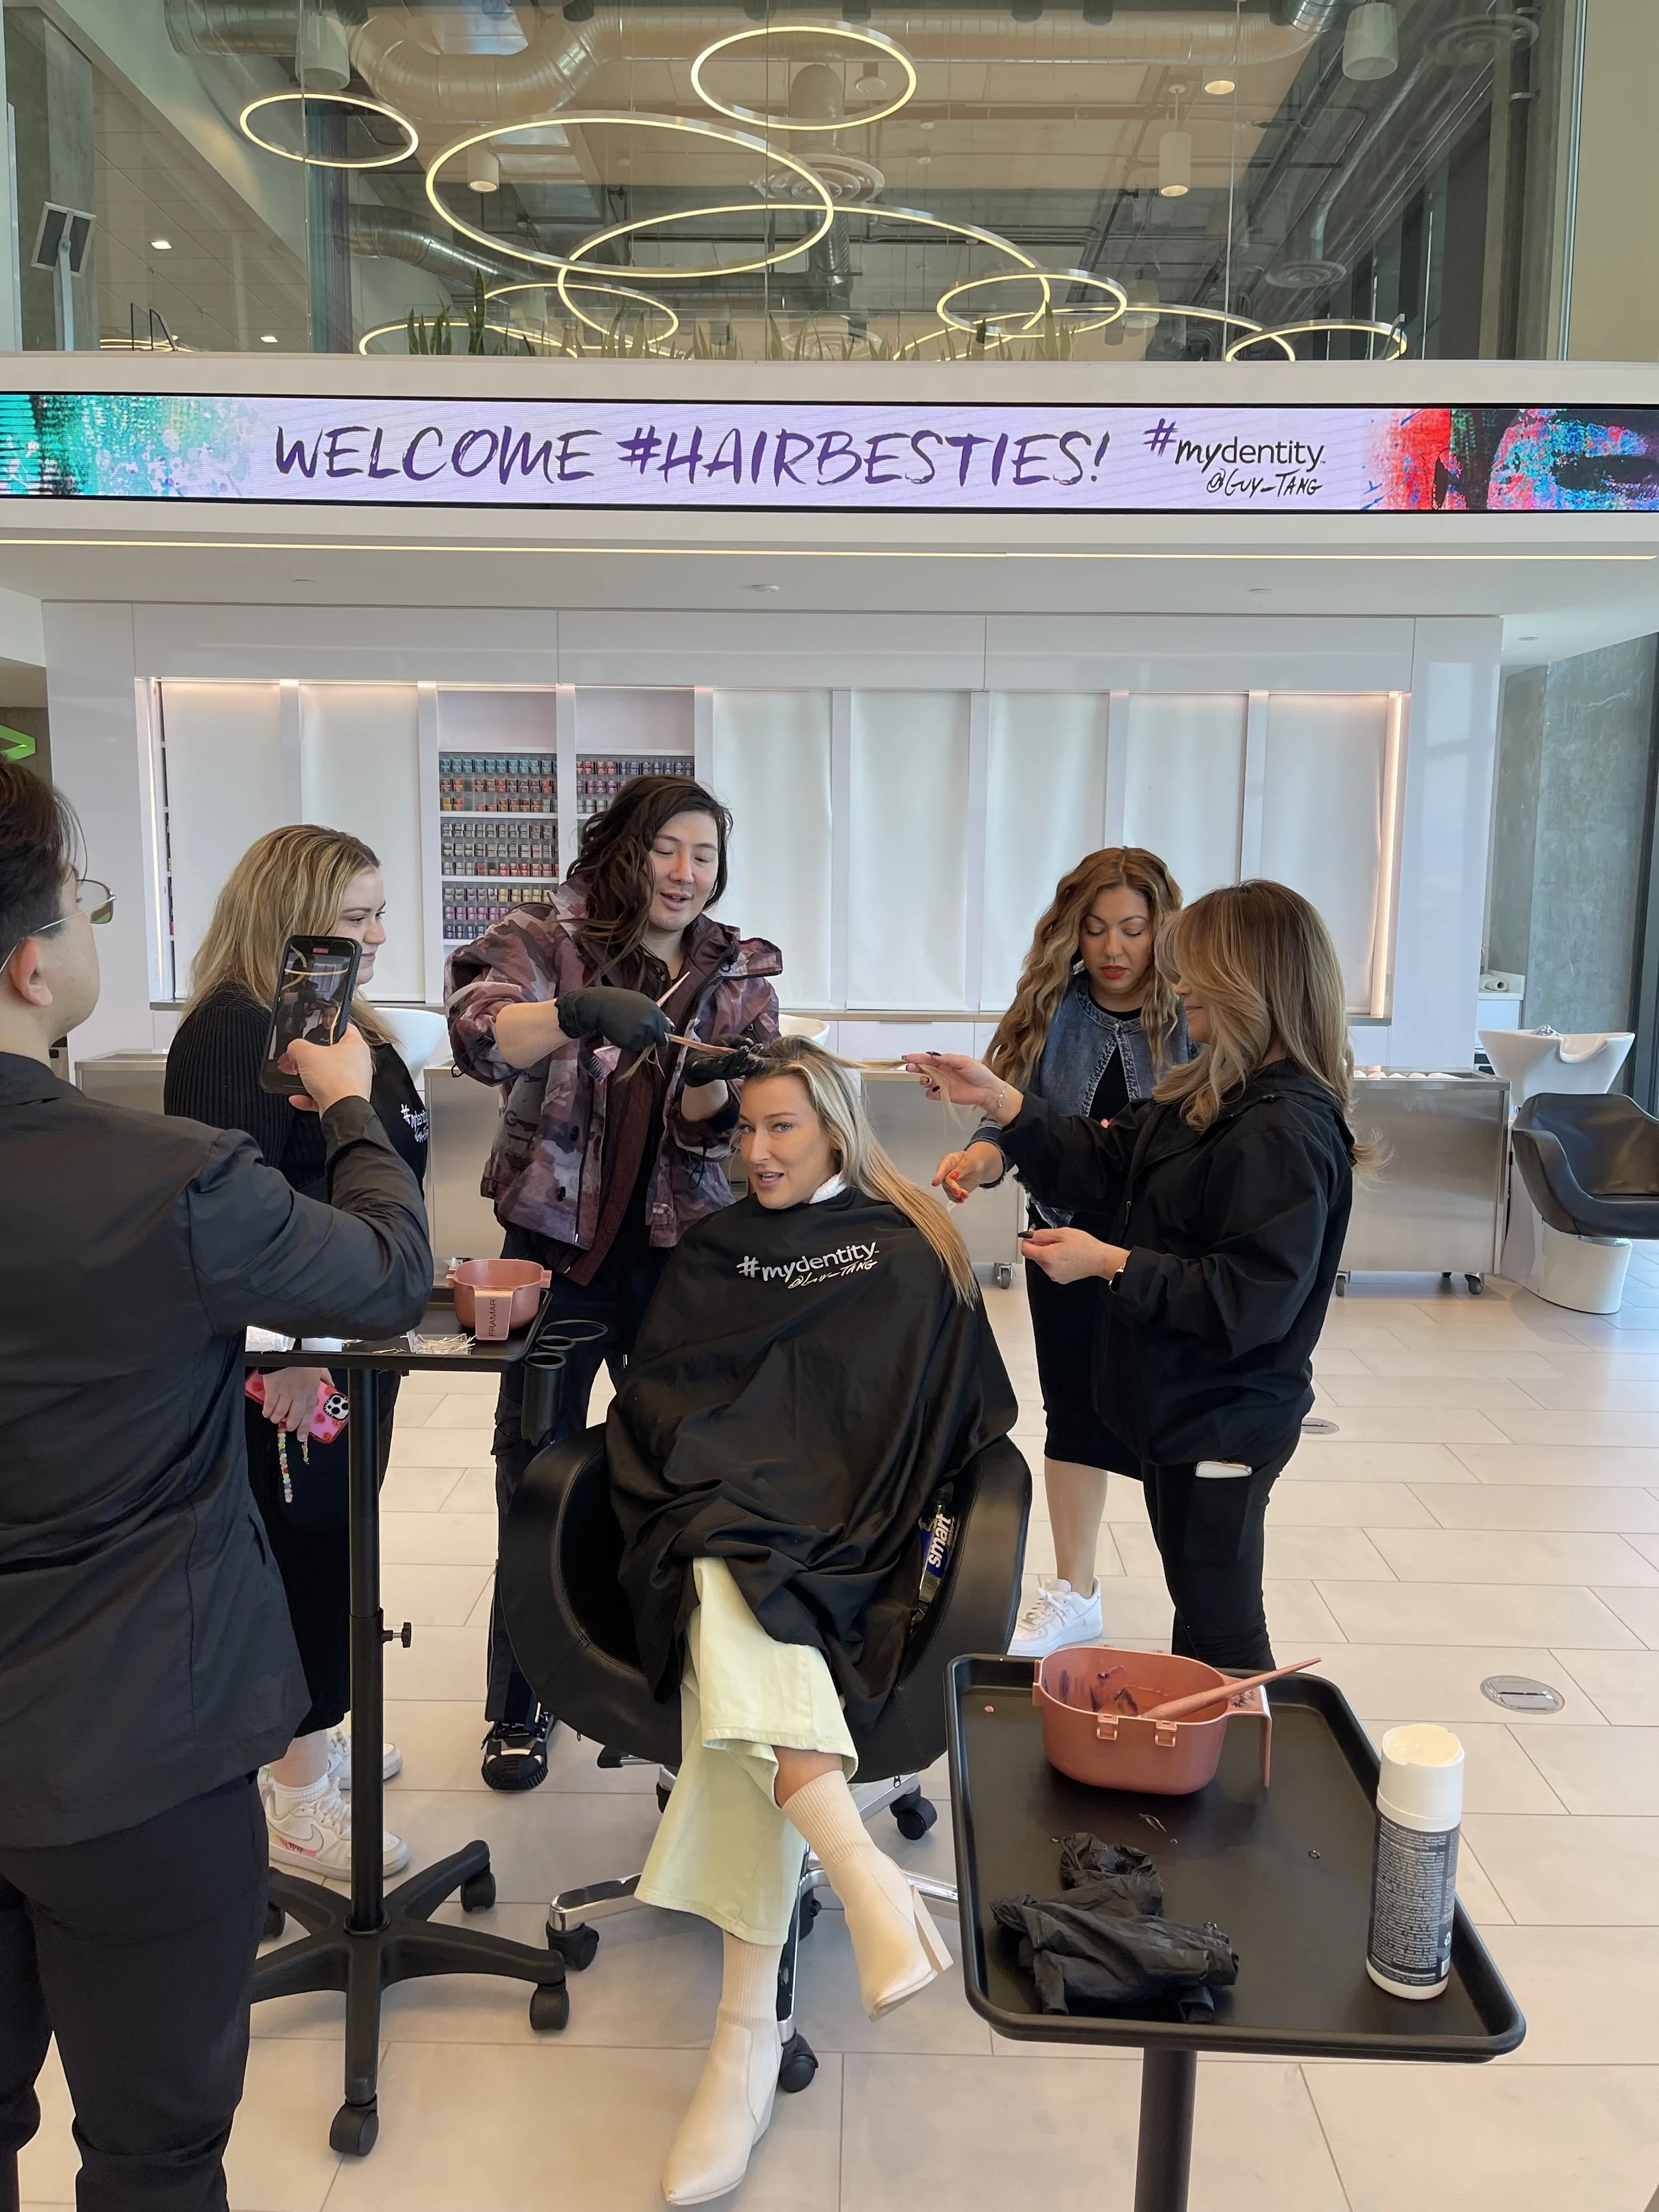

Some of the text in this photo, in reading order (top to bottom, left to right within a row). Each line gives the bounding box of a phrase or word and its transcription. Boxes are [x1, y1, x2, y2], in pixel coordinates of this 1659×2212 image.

[275, 425, 1110, 487] WELCOME #HAIRBESTIES!
[488, 1299, 498, 1337] FRAMAR
[928, 1512, 952, 1568] smart
